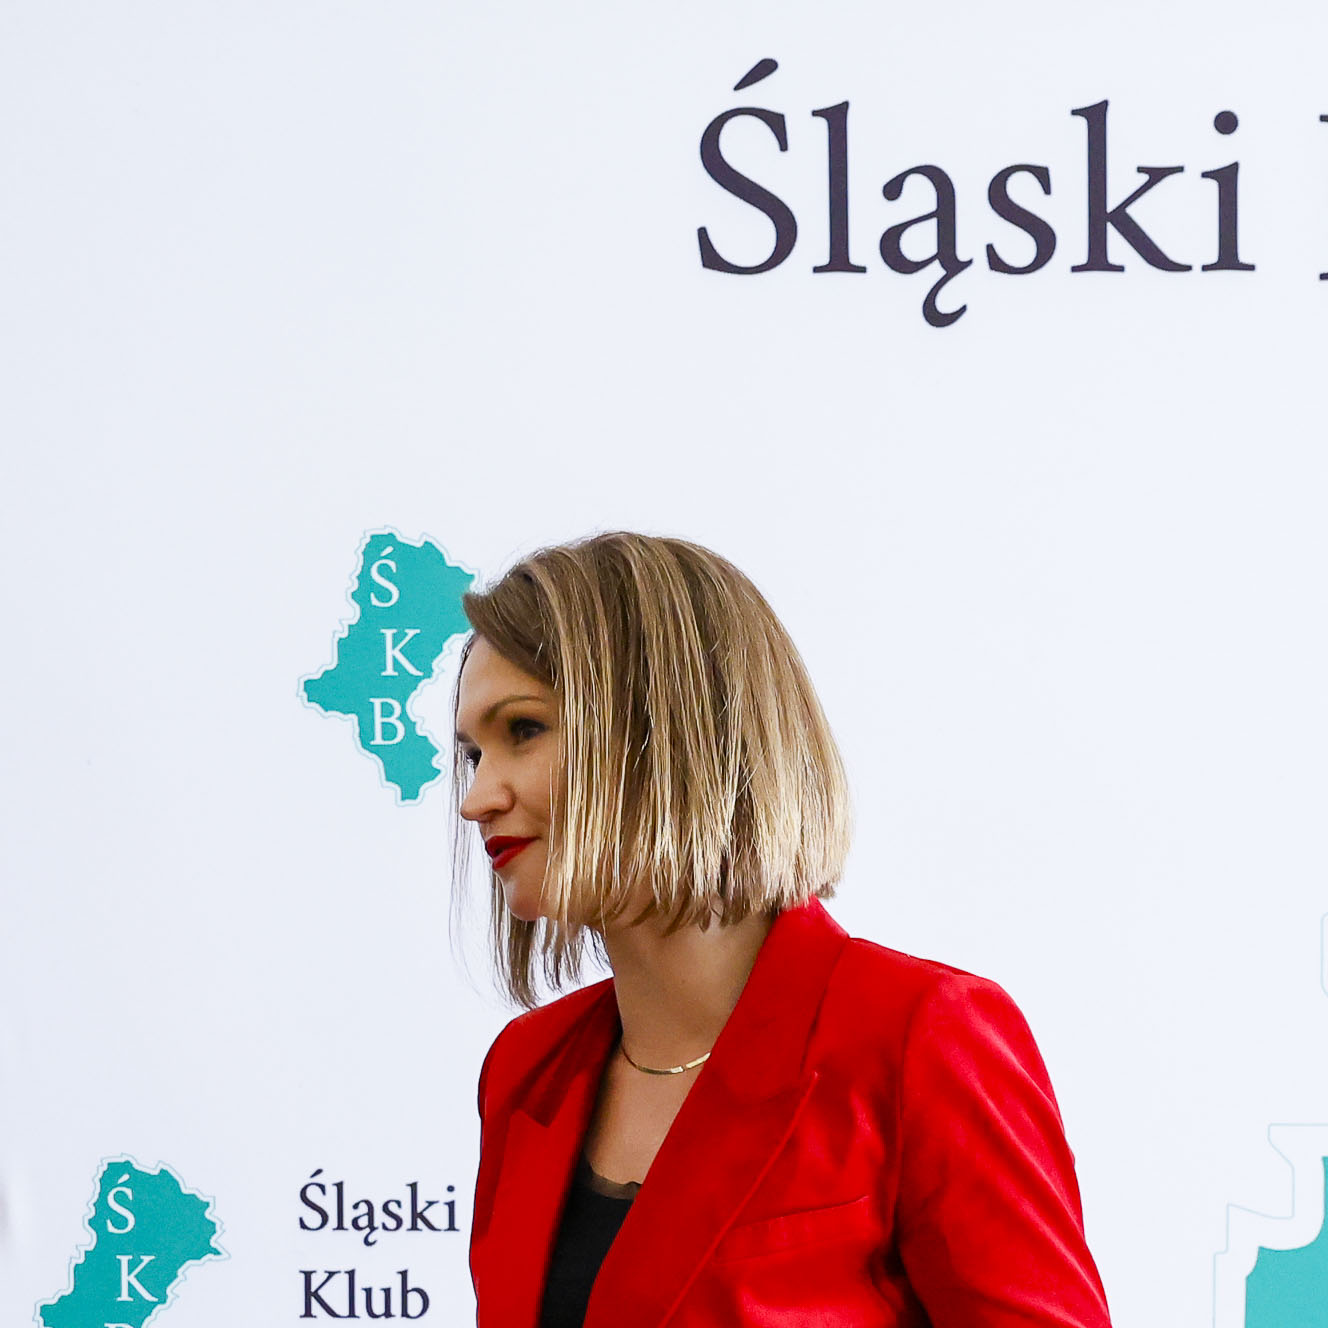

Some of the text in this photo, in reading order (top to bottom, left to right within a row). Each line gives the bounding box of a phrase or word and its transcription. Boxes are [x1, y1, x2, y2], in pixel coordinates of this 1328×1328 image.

[695, 58, 1257, 329] Śląski
[298, 1168, 461, 1247] Śląski
[298, 1268, 431, 1320] Klub
